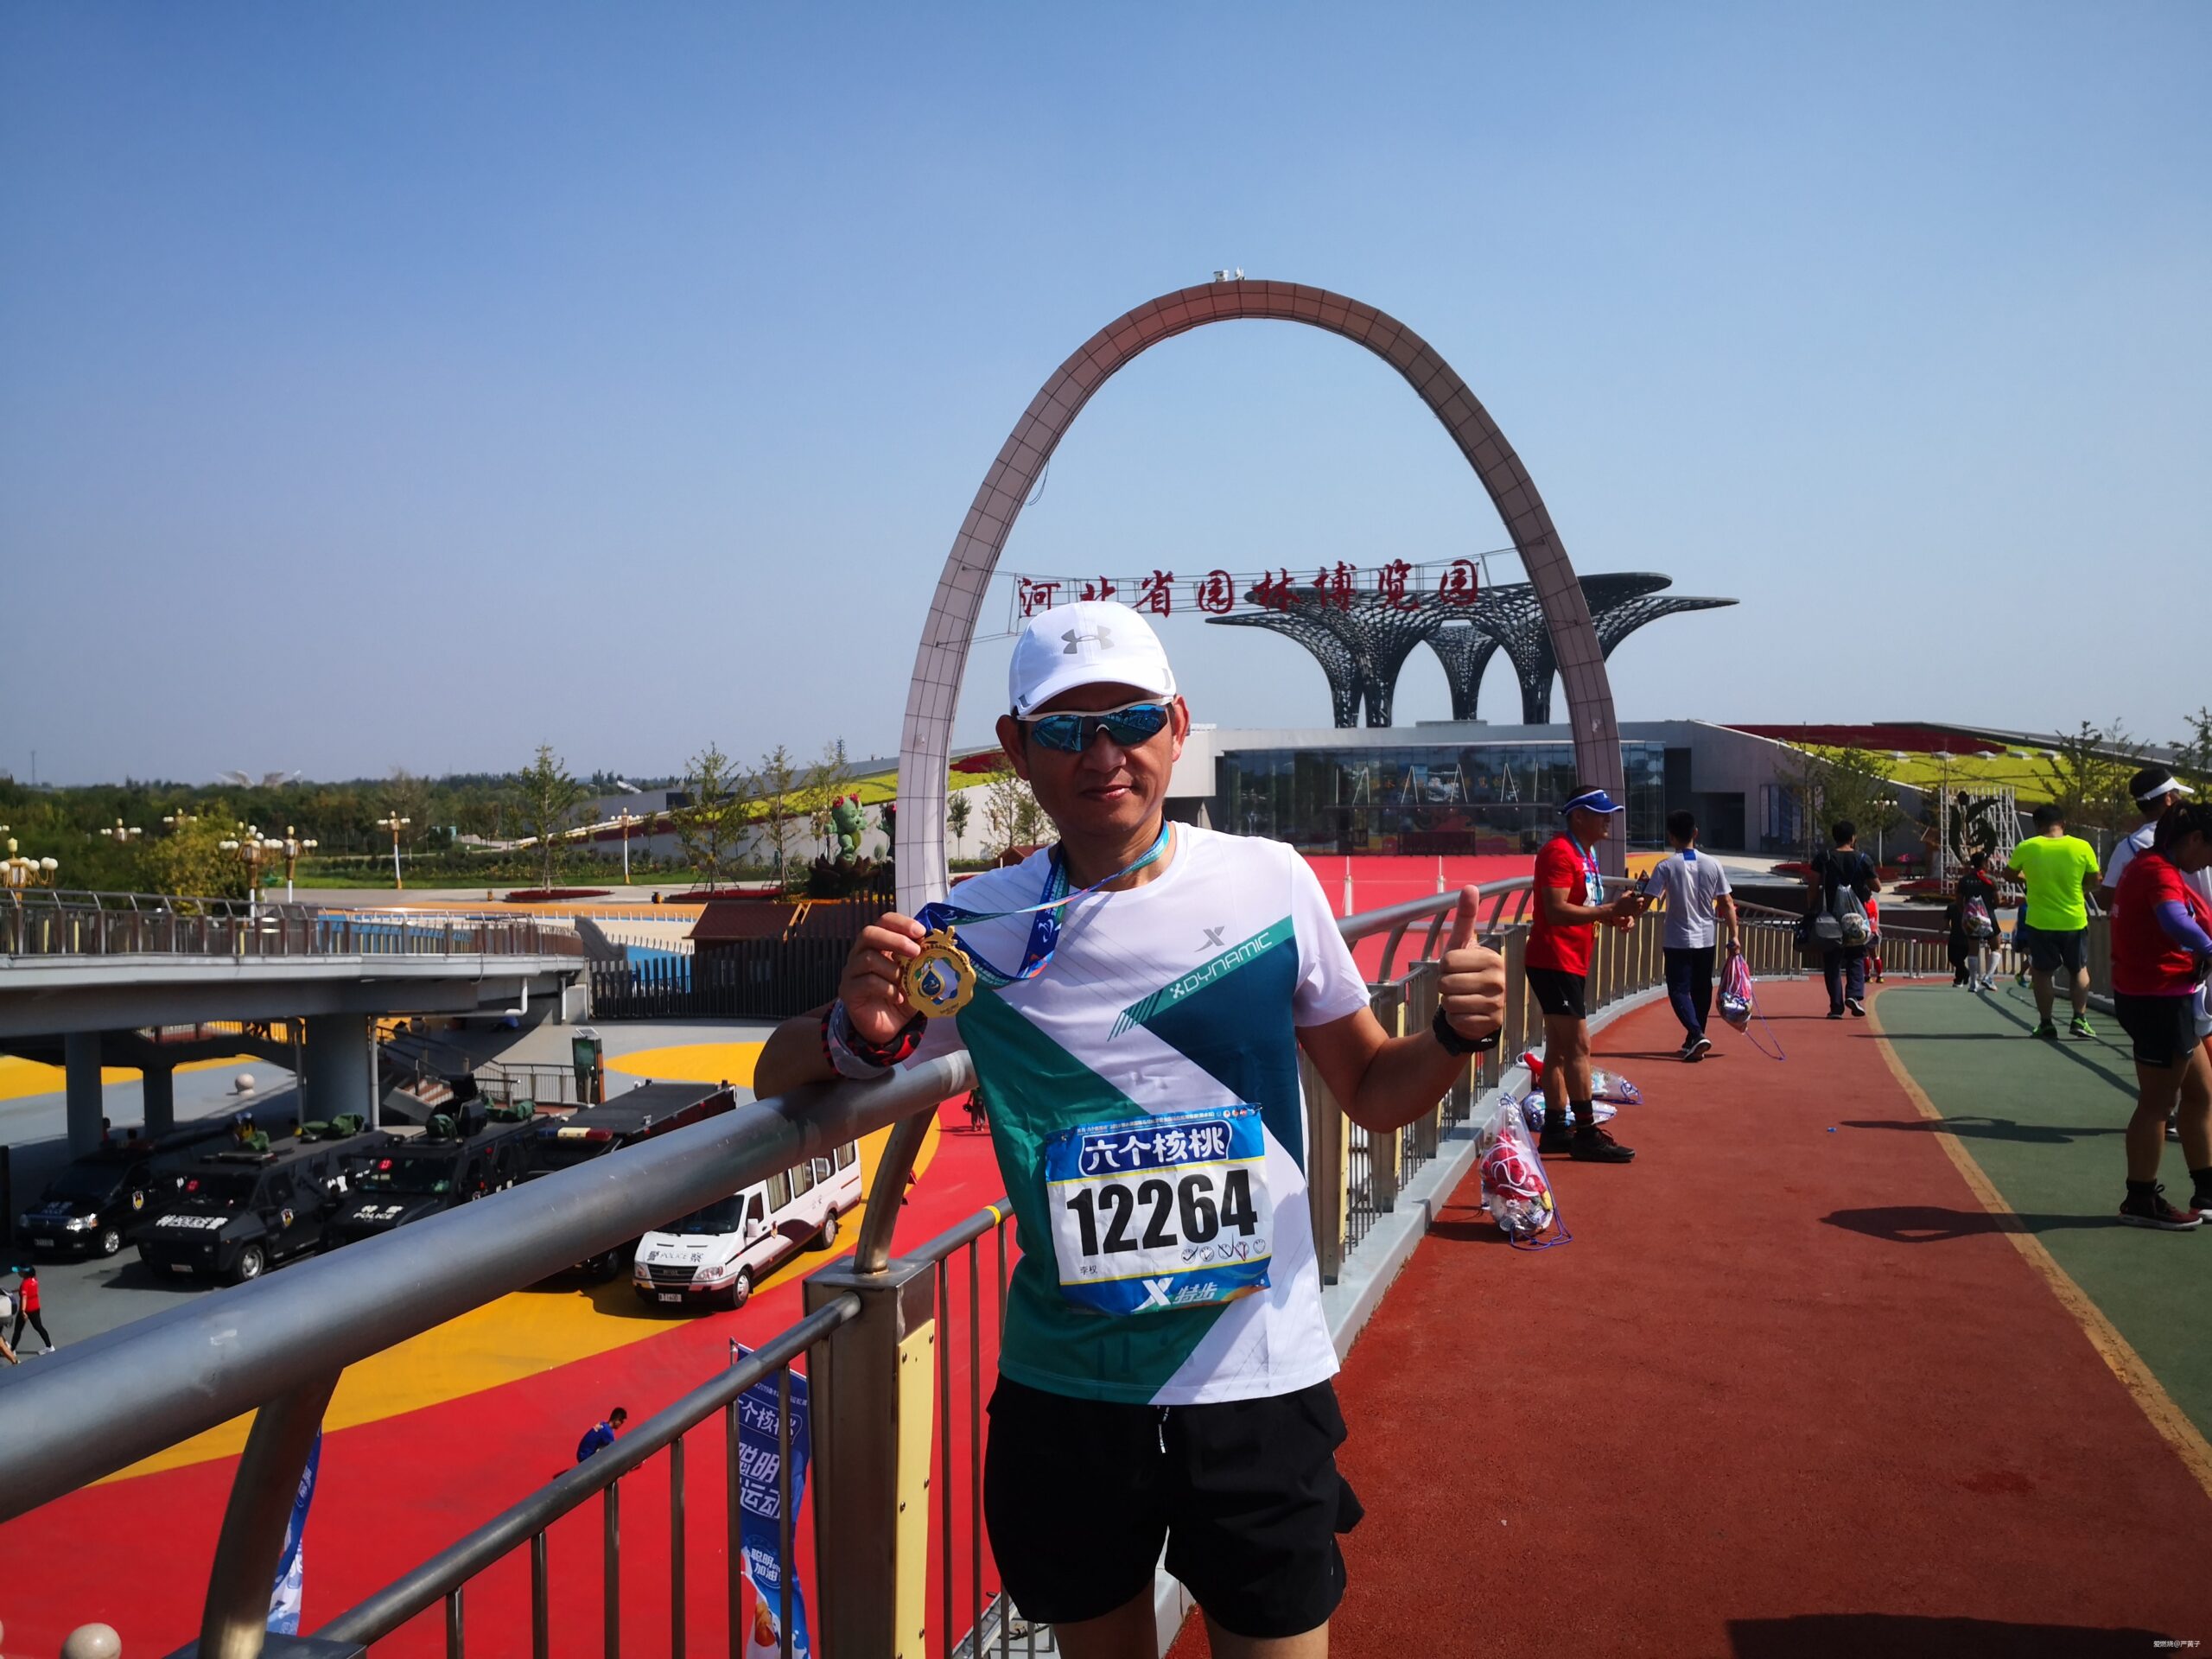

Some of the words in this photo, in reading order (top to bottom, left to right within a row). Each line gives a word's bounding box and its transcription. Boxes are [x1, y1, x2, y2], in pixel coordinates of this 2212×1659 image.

[1084, 1126, 1226, 1172] 六个核桃
[1066, 1169, 1258, 1257] 12264
[1173, 1281, 1217, 1305] 特步
